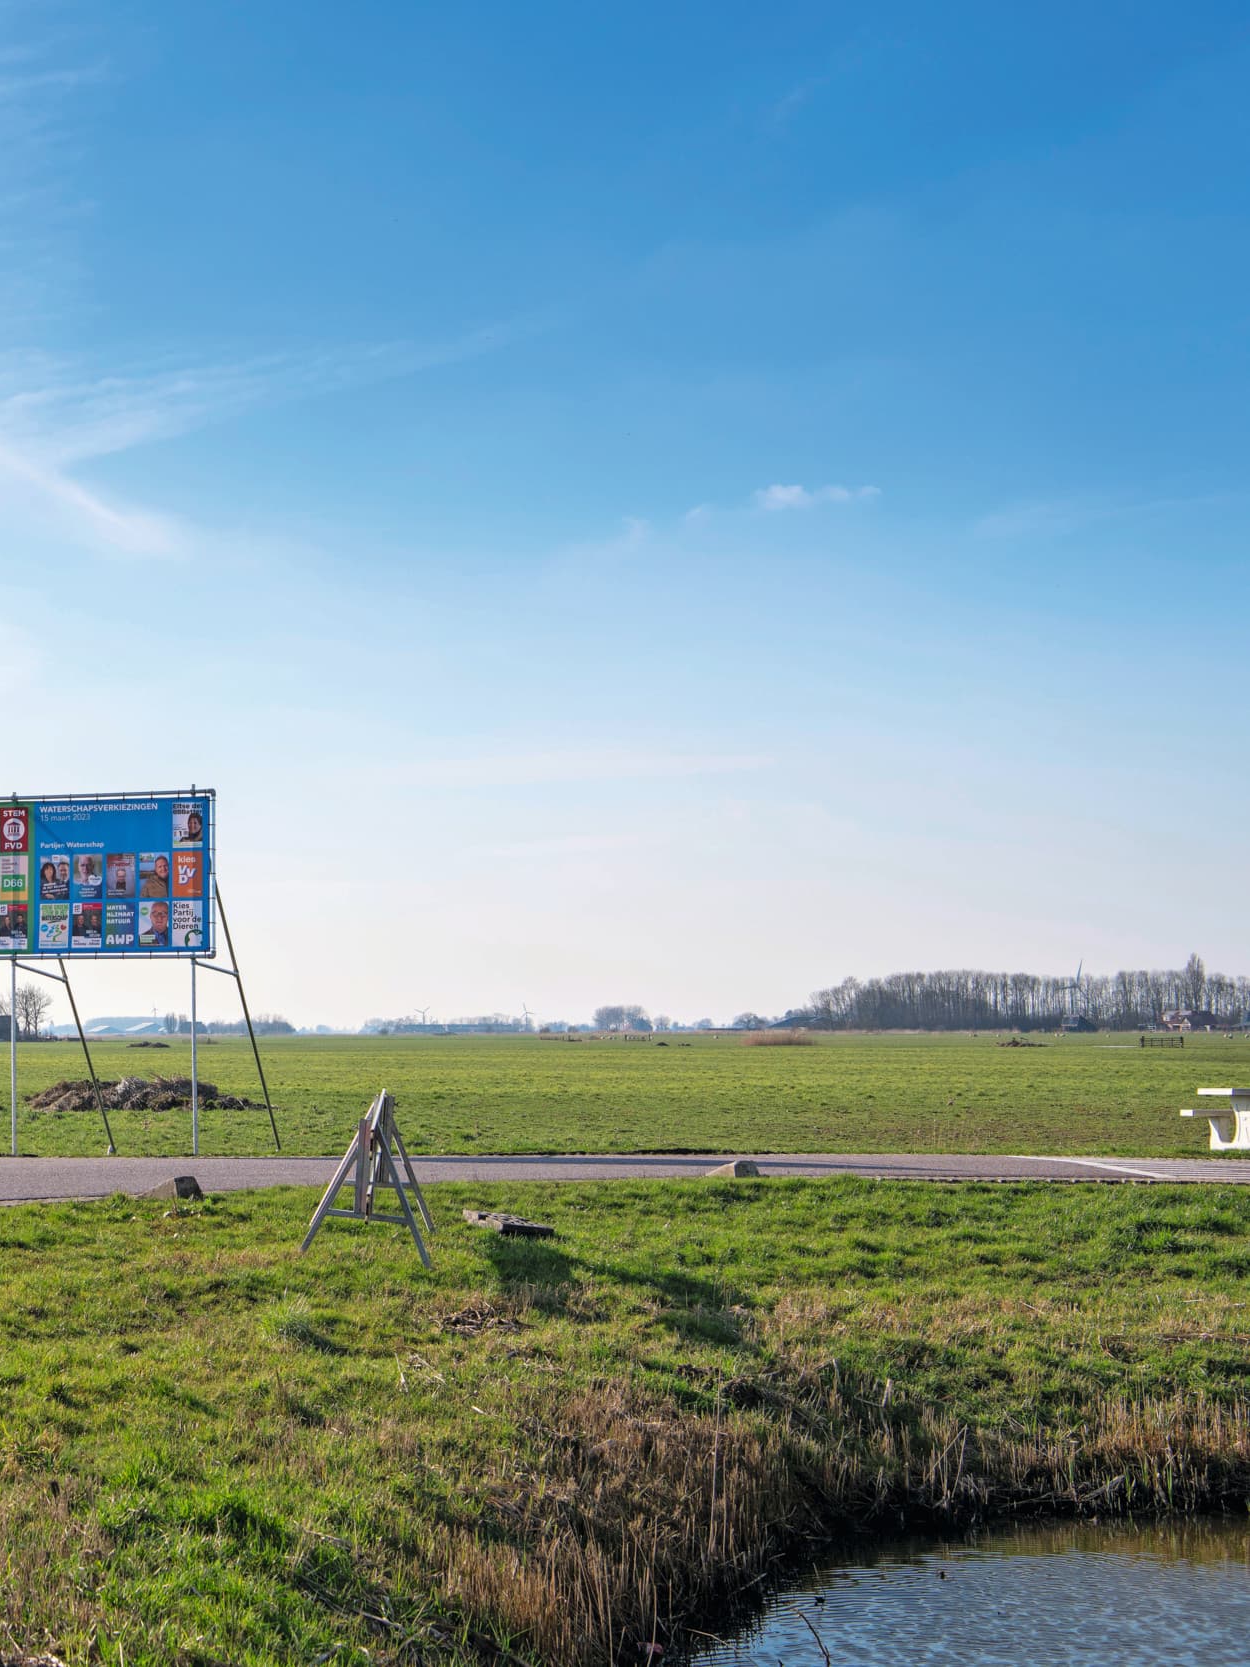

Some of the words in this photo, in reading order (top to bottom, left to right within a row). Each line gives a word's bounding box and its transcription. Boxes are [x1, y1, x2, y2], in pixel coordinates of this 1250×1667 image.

[39, 803, 158, 813] WATERSCHAPSVERKIEZINGEN
[41, 814, 49, 822] 15
[72, 813, 91, 821] 2023
[4, 842, 23, 850] FVD
[40, 842, 65, 850] Partijen
[66, 841, 104, 849] Waterschap
[4, 879, 23, 888] D66
[173, 909, 194, 917] Partij
[106, 934, 134, 945] AWP
